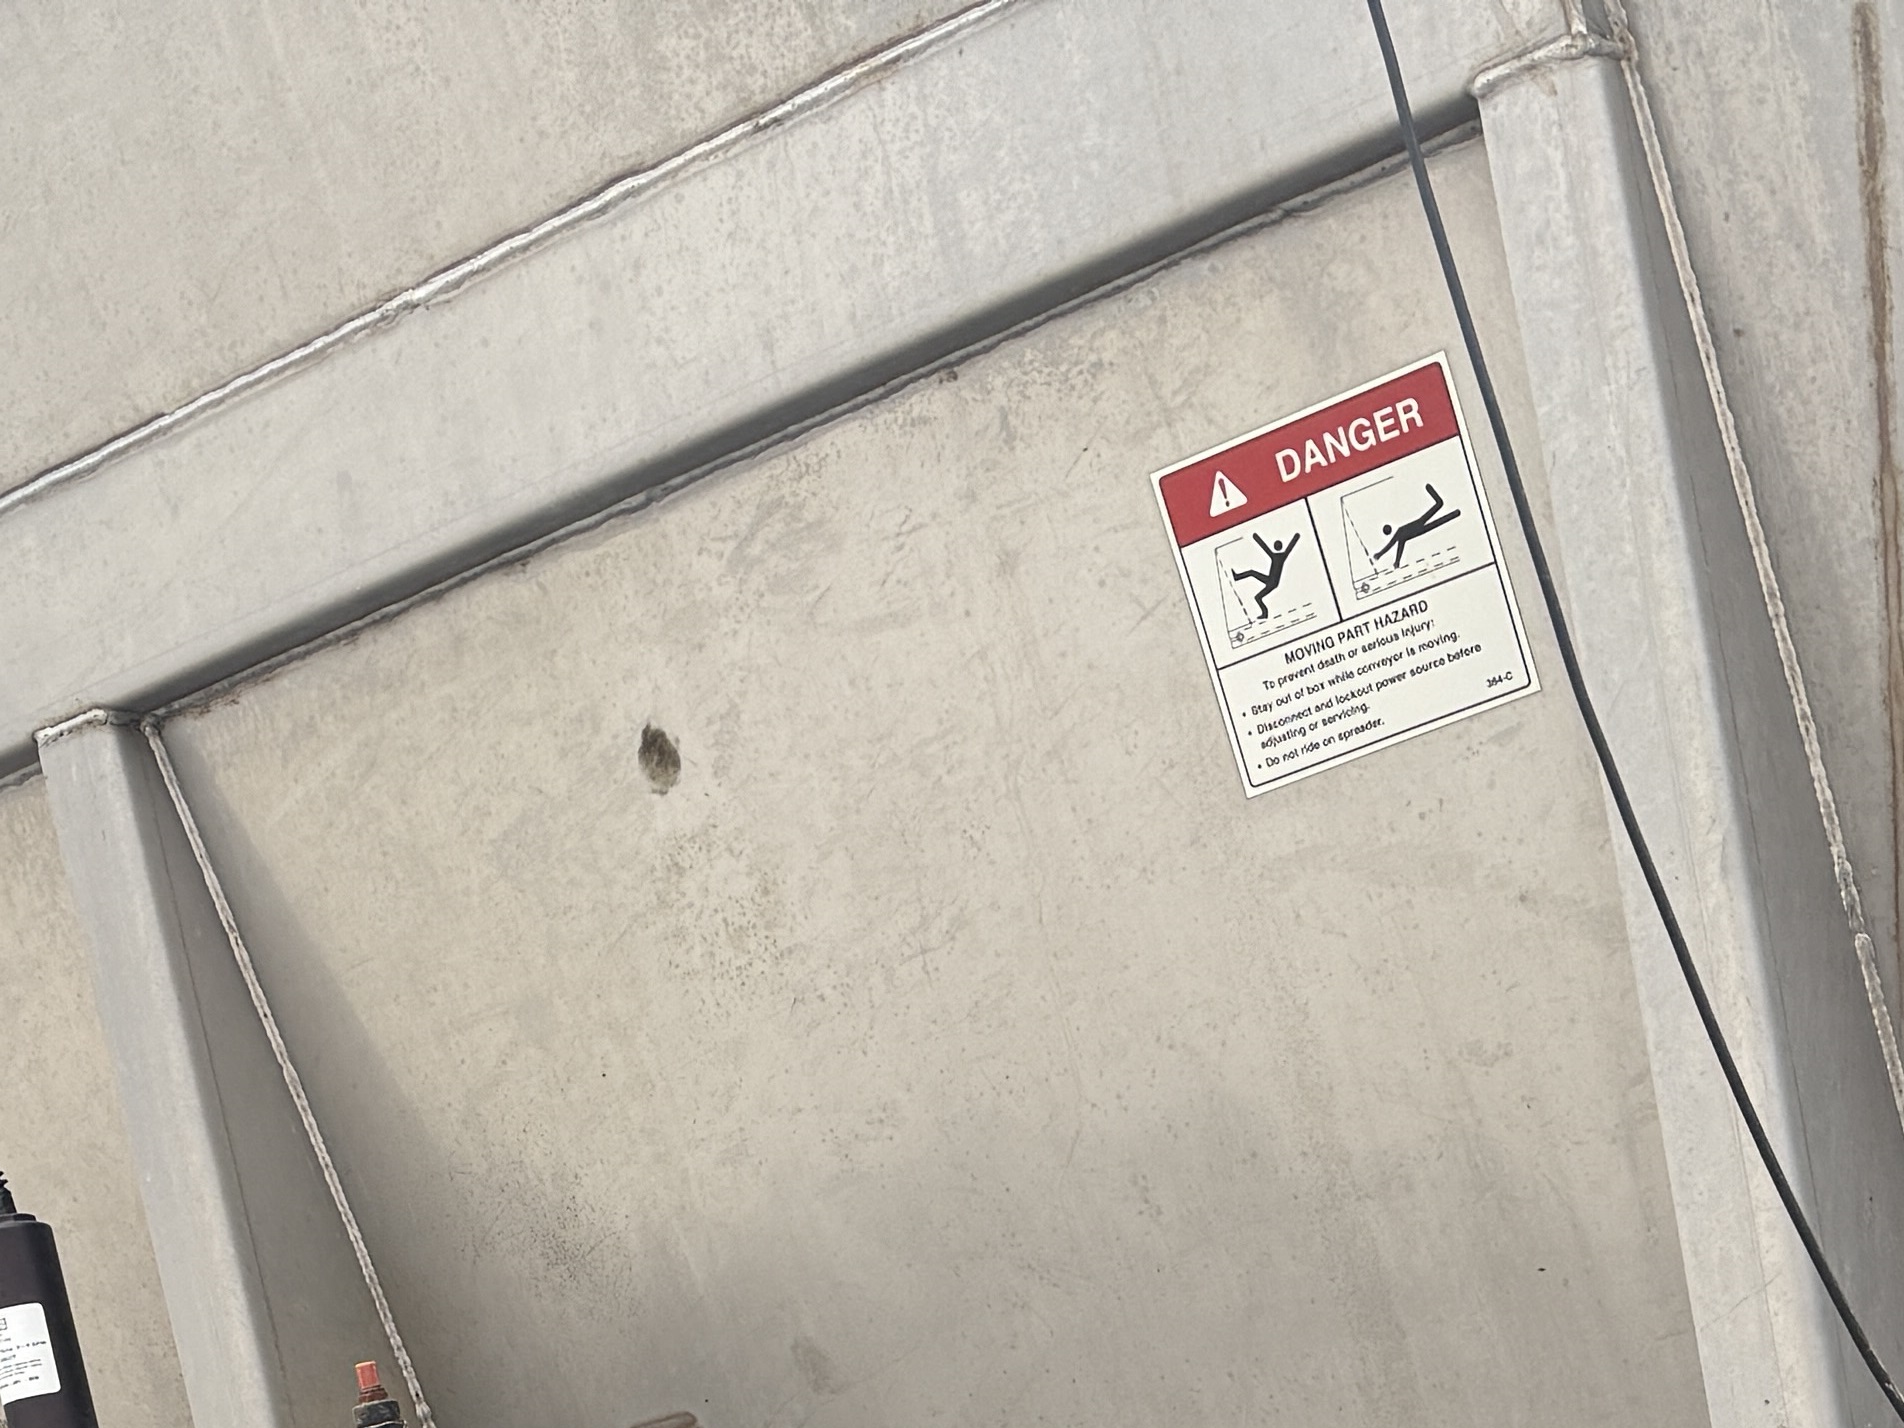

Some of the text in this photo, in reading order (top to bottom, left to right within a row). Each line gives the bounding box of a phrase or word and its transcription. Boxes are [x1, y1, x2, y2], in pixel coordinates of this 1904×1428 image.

[1275, 397, 1425, 484] DANGER
[1262, 680, 1276, 690] To
[1278, 664, 1315, 688] prevent
[1317, 653, 1346, 670] death
[1348, 648, 1358, 658] or
[1361, 633, 1400, 653] serious
[1285, 600, 1428, 664] MOVING PART HAZARD
[1251, 632, 1460, 715] Stay out of box while conveyor is moving.
[1257, 644, 1482, 734] Disconnect and lockout power source before
[1261, 703, 1370, 749] adjusting or servicing.
[1265, 717, 1385, 767] Do not ride on spreader.
